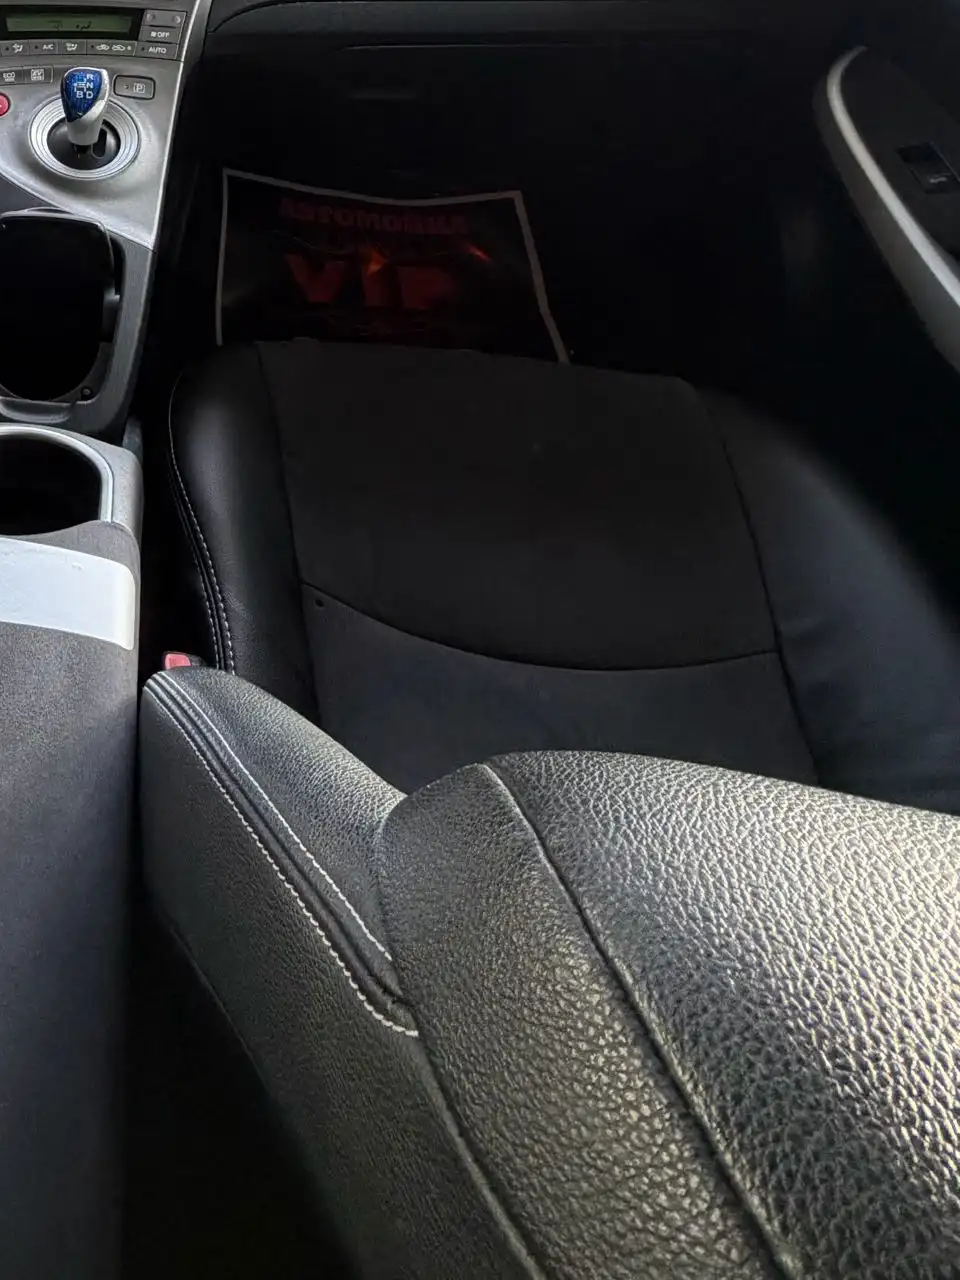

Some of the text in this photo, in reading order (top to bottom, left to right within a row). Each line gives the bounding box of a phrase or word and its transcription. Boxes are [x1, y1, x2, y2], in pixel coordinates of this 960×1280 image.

[148, 46, 167, 54] AUTO
[86, 81, 94, 89] N
[76, 90, 94, 99] B D
